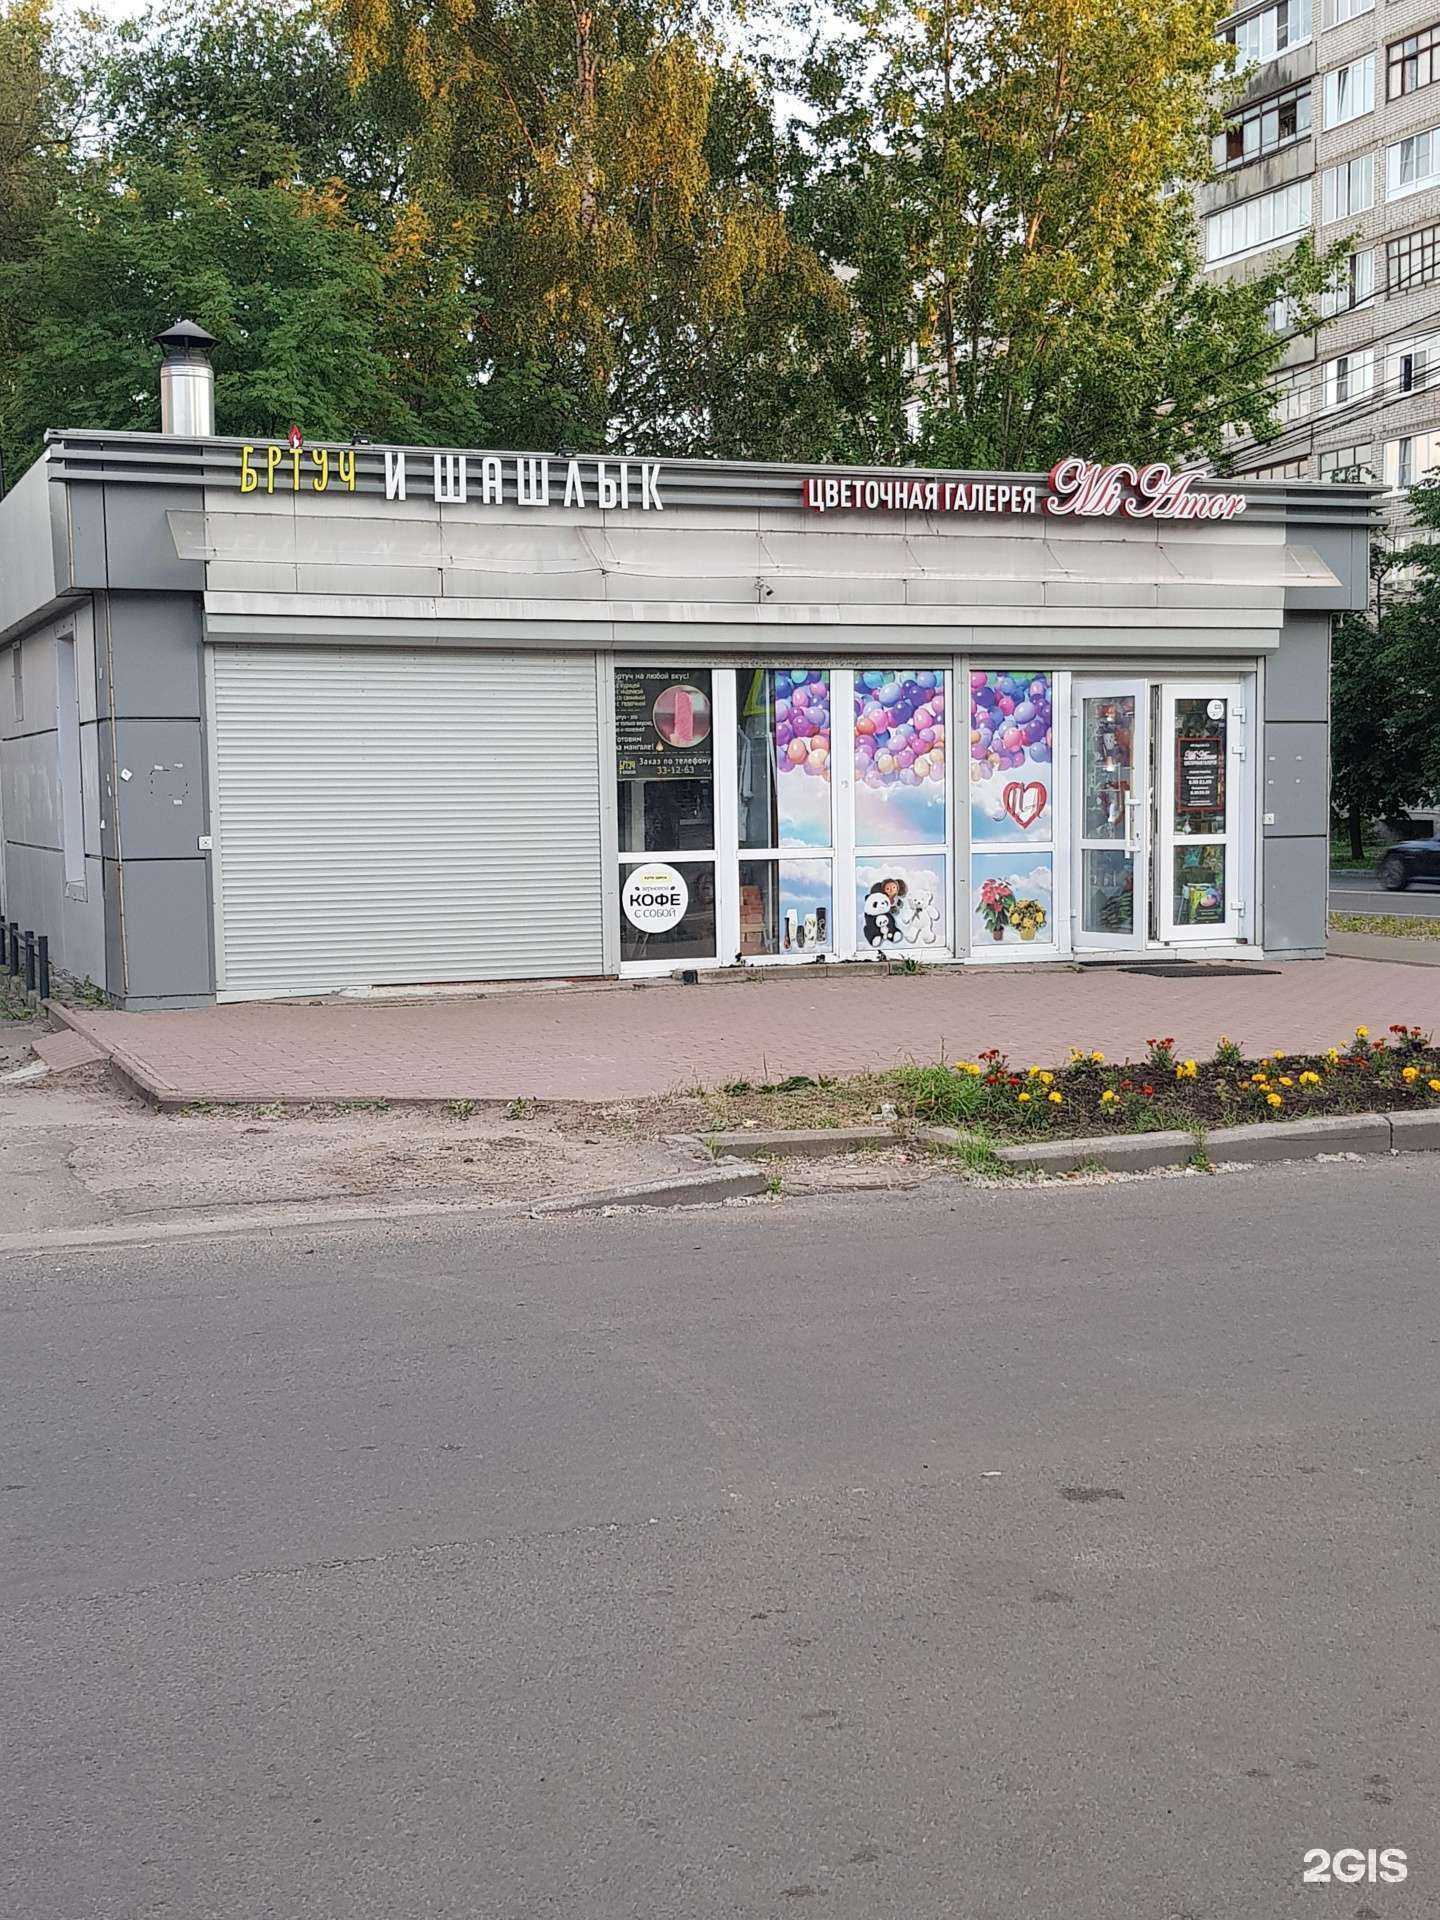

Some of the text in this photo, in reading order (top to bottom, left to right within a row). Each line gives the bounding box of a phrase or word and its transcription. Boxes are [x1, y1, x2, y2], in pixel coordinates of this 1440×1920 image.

[241, 445, 664, 511] БРТУЧ И ШАШЛЫК
[804, 478, 1037, 514] ЦВЕТОЧНАЯ ГАЛЕРЕЯ
[1045, 458, 1247, 520] Mi Amor
[639, 757, 661, 766] Заказ
[676, 757, 712, 766] телефону
[656, 766, 695, 774] 33-12-63
[629, 893, 681, 907] КОФЕ
[643, 907, 677, 918] СОБОЙ
